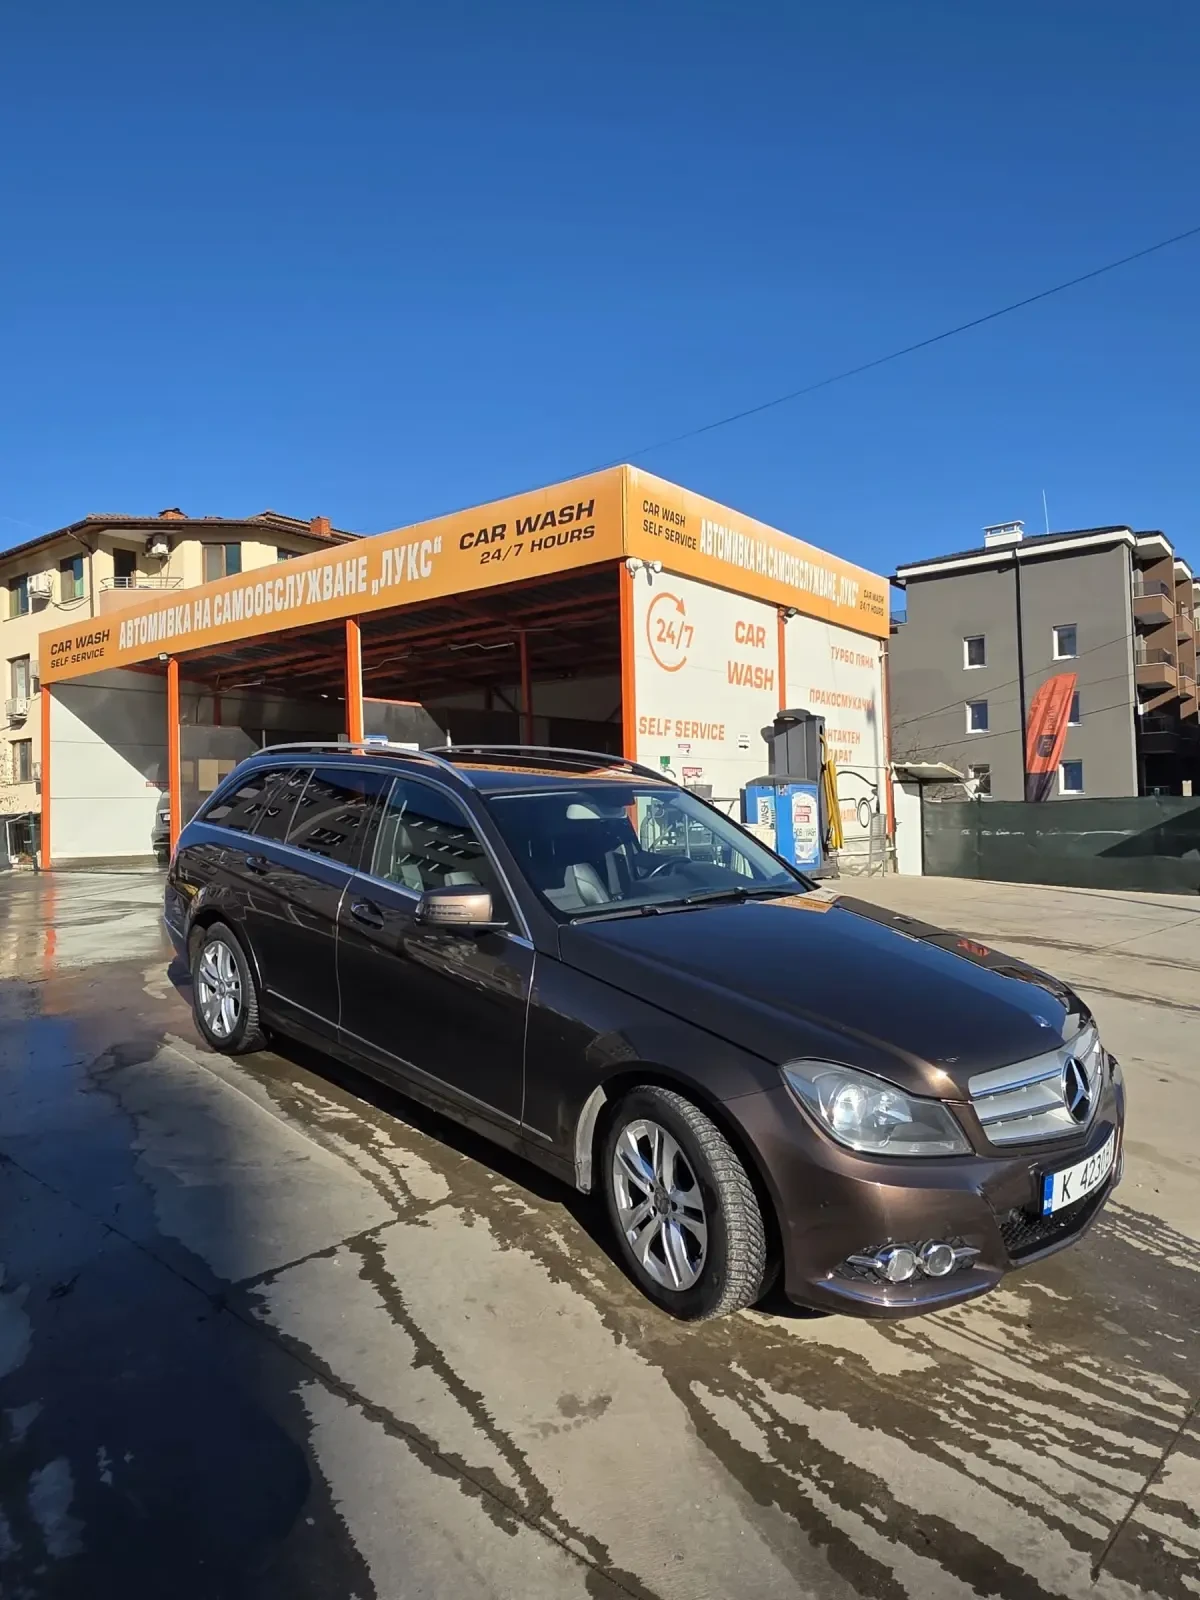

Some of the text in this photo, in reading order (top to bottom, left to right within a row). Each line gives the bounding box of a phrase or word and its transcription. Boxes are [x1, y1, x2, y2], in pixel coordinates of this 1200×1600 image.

[459, 499, 595, 550] CAR WASH
[642, 500, 686, 528] CAR WASH
[480, 525, 596, 564] 24/7 HOURS
[642, 519, 697, 550] SELF SERVICE
[700, 517, 755, 573] АВТОМИВКА
[756, 540, 768, 579] НА
[119, 603, 191, 650] АВТОМИВКА
[194, 597, 212, 631] НА
[213, 556, 368, 626] САМООБСЛУЖВАНЕ
[860, 601, 884, 616] 24/7 HOURS
[863, 589, 885, 604] CAR WASH
[50, 629, 110, 656] CAR WASH
[656, 617, 695, 650] 24/7
[735, 620, 766, 649] CAR
[50, 648, 105, 669] SELF SERVICE
[831, 646, 875, 669] ТУРБО ПЯНА
[727, 660, 774, 691] WASH
[639, 716, 672, 737] SELF
[675, 720, 725, 741] SERVICE
[1061, 1171, 1073, 1203] K
